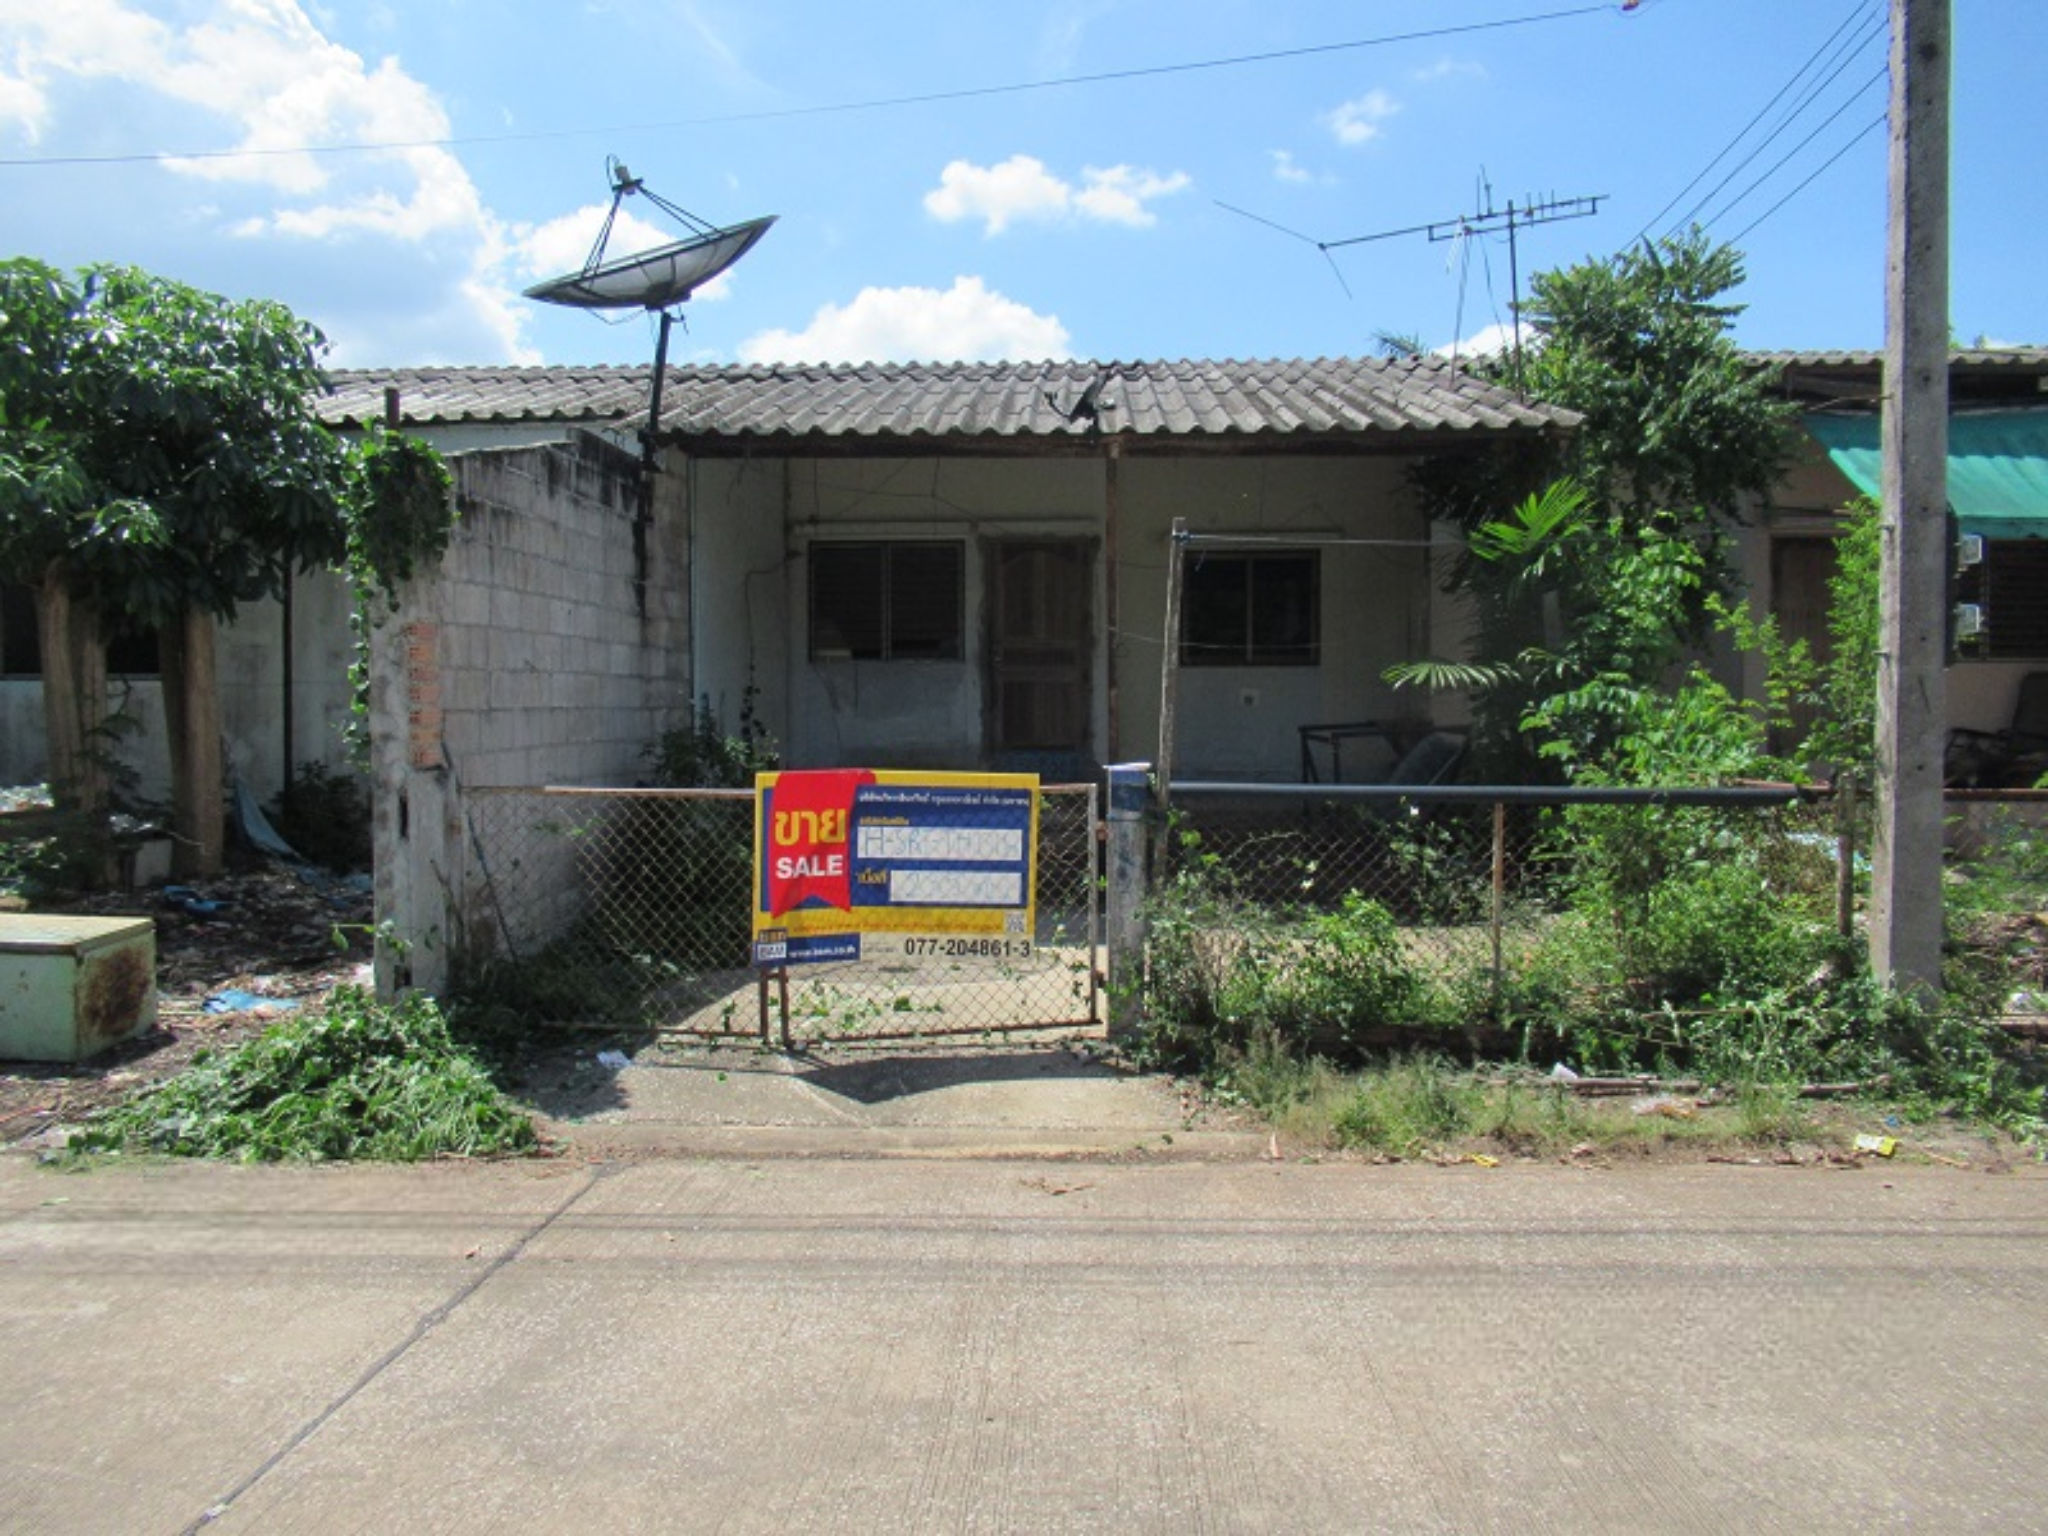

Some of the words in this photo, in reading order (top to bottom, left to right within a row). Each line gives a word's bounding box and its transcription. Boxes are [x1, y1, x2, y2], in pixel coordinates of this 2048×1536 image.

[775, 808, 846, 846] ขาย
[776, 854, 843, 879] SALE
[905, 937, 1031, 958] 077-204861-3
